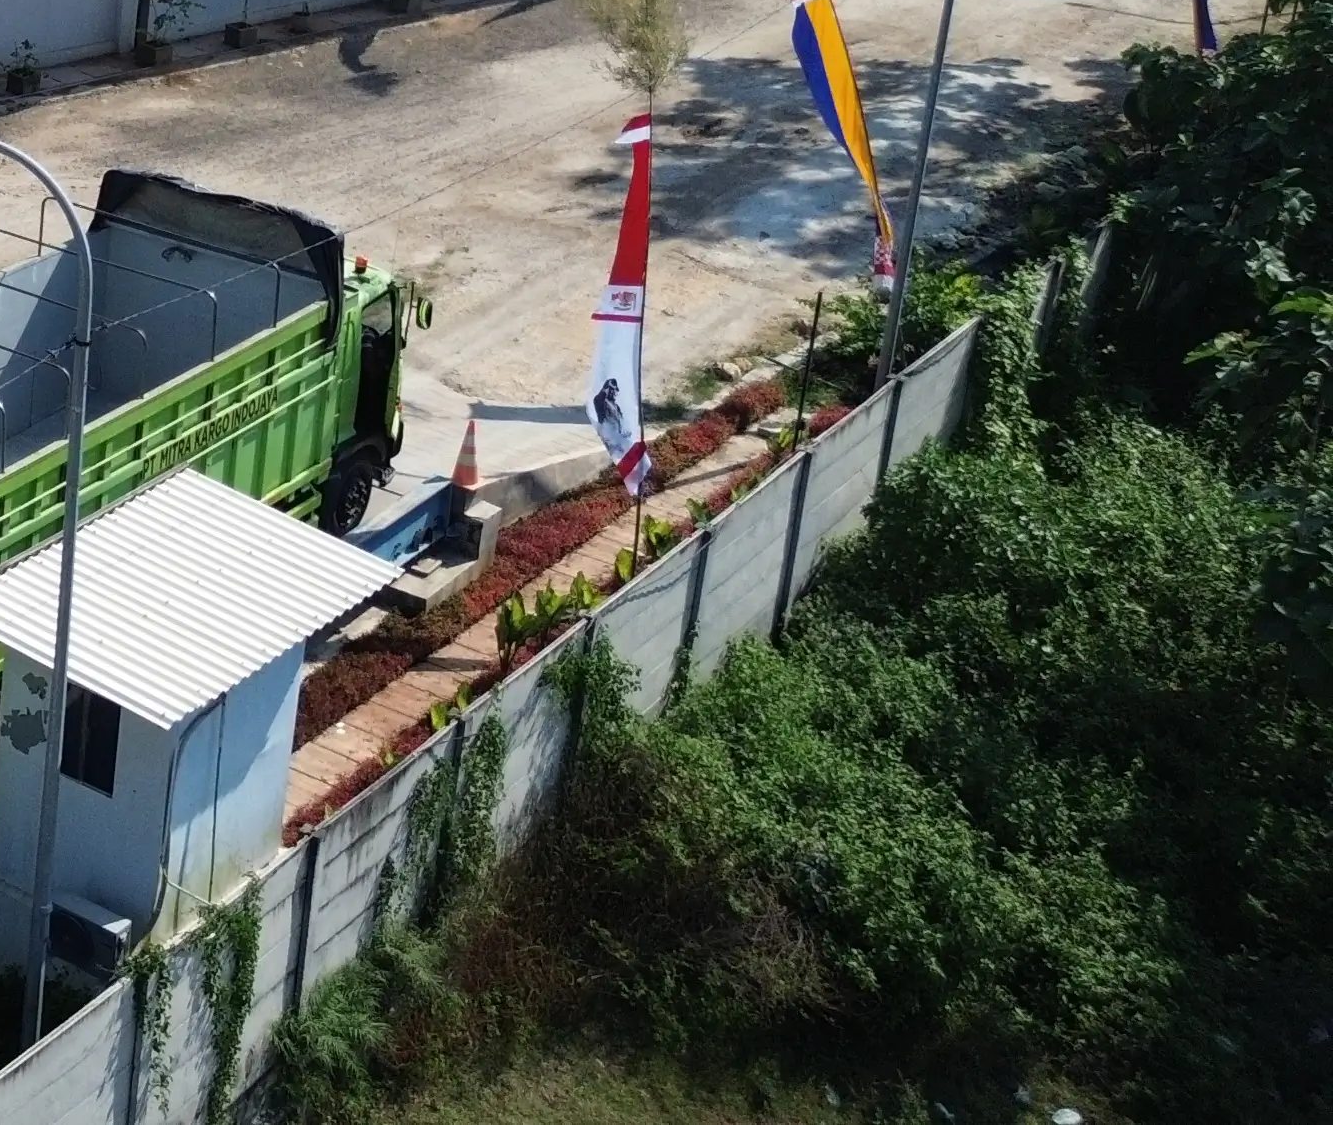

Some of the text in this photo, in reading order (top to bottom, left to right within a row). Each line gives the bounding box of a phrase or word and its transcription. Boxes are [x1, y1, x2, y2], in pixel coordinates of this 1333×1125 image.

[142, 385, 278, 477] PT MITRA KARGO INDOJAYA
